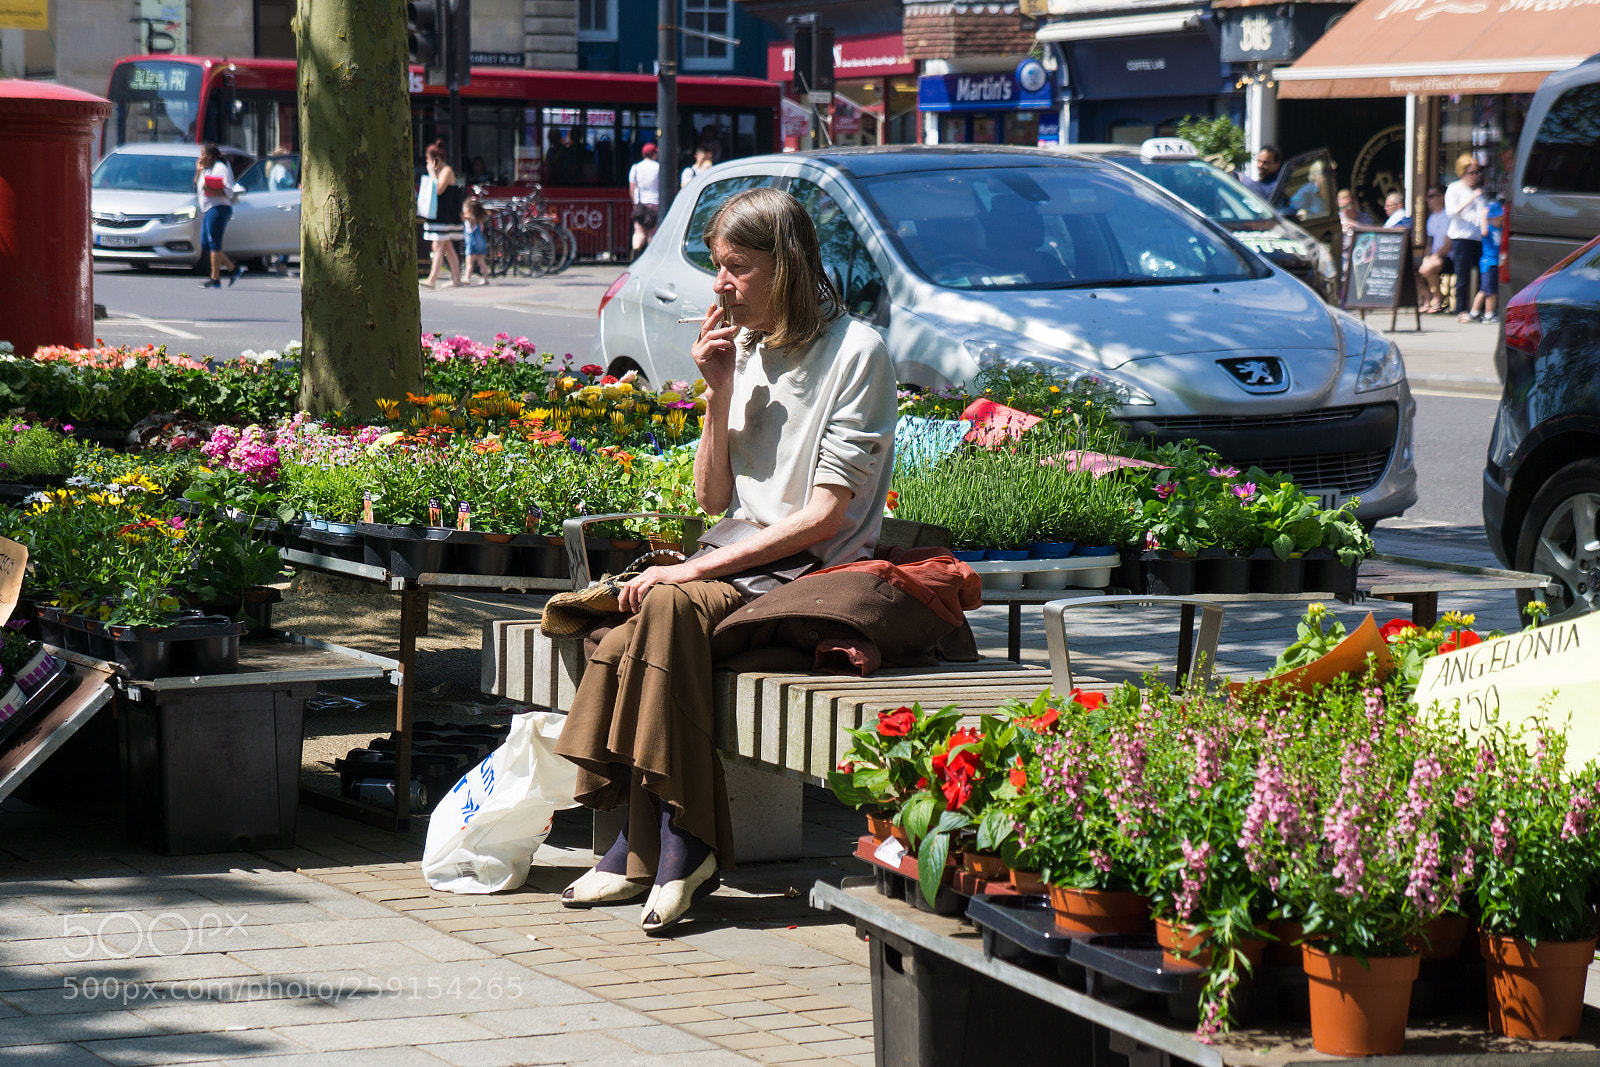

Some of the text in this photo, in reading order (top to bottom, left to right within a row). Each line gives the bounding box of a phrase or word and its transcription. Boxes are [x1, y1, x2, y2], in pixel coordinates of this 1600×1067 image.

[956, 75, 1012, 101] Martin's
[1154, 144, 1194, 154] TAXI
[1429, 622, 1581, 693] ANGELONIA
